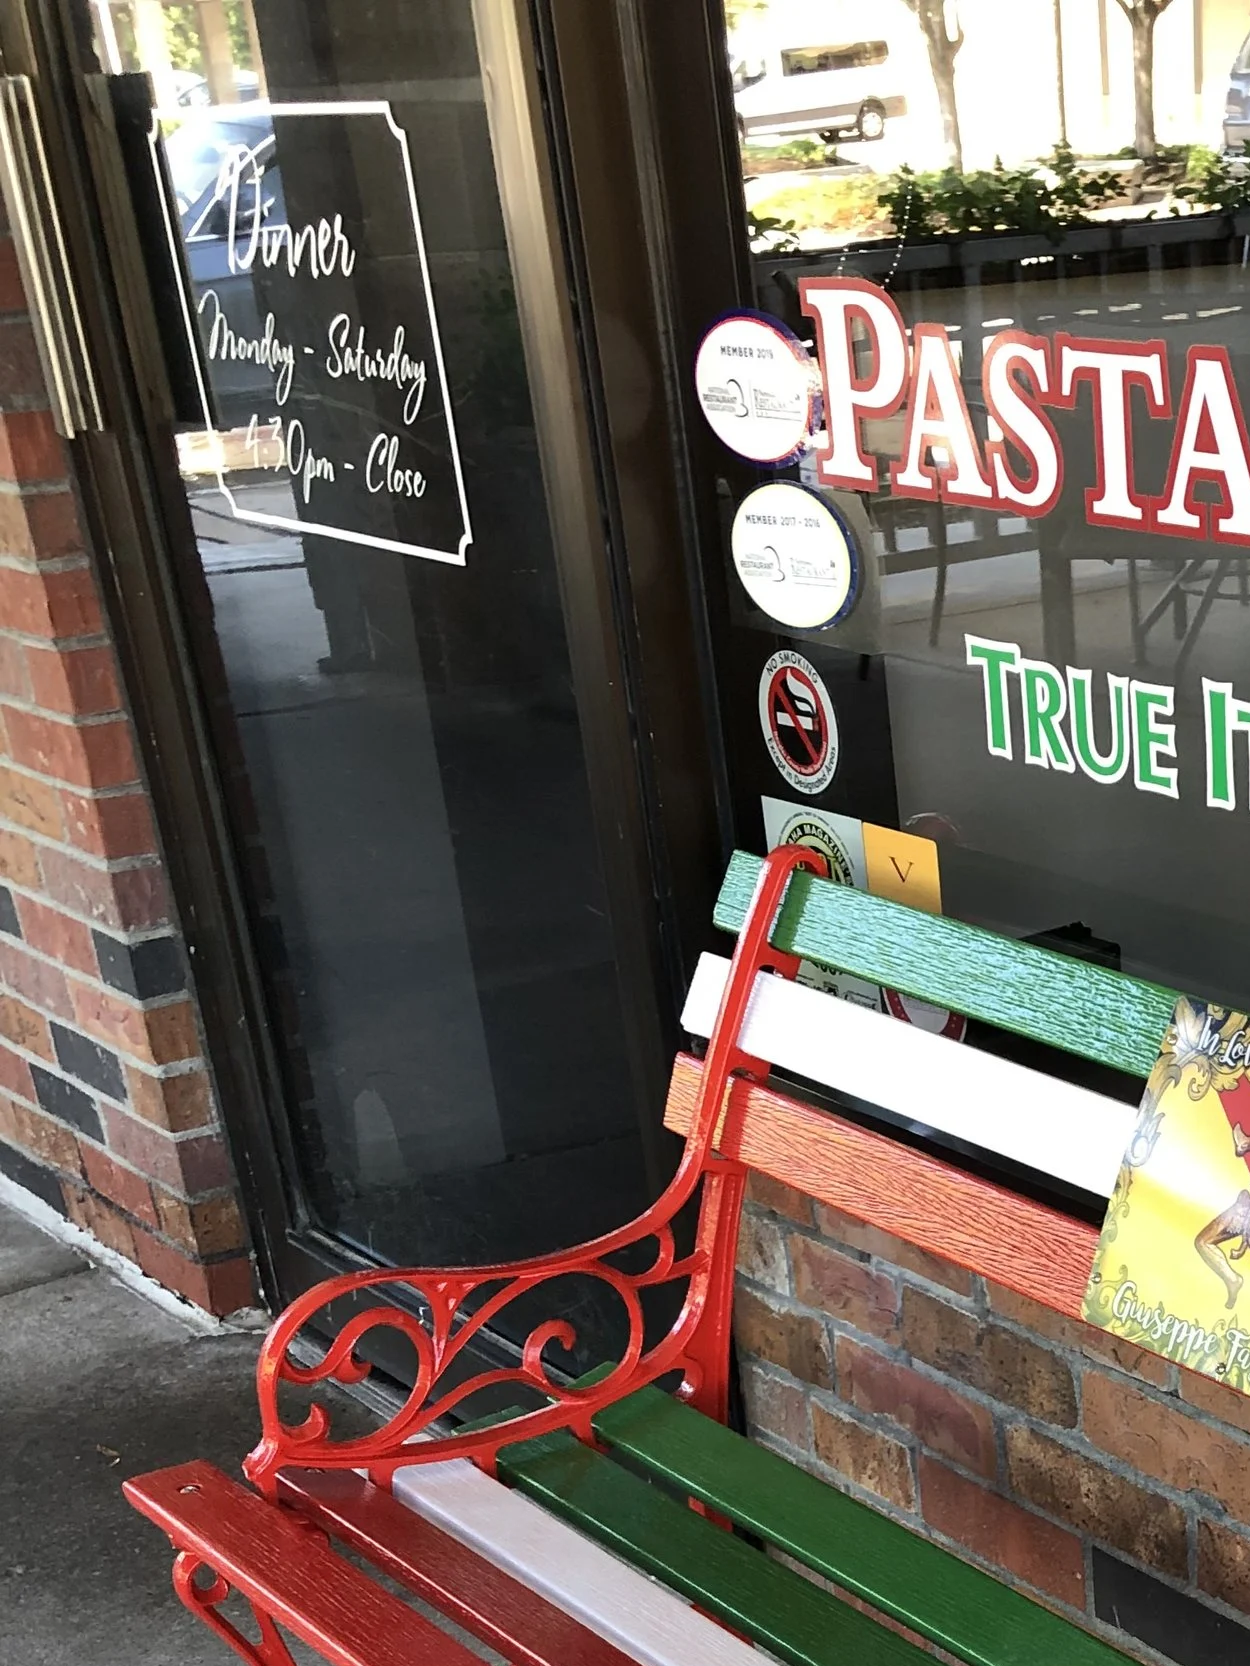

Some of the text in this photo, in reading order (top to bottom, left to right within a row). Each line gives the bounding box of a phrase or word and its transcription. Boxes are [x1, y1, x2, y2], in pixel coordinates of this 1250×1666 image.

[215, 143, 356, 279] Dinner
[197, 288, 296, 406] Monday
[326, 312, 427, 425] Saturday
[720, 345, 753, 358] MEMBER
[365, 432, 427, 498] Close
[745, 514, 777, 526] MEMBER
[766, 652, 819, 684] NO SMOKING
[964, 632, 1179, 800] TRUE
[889, 856, 915, 883] V
[1195, 1016, 1220, 1056] In
[1112, 1280, 1218, 1360] Giuseppe
